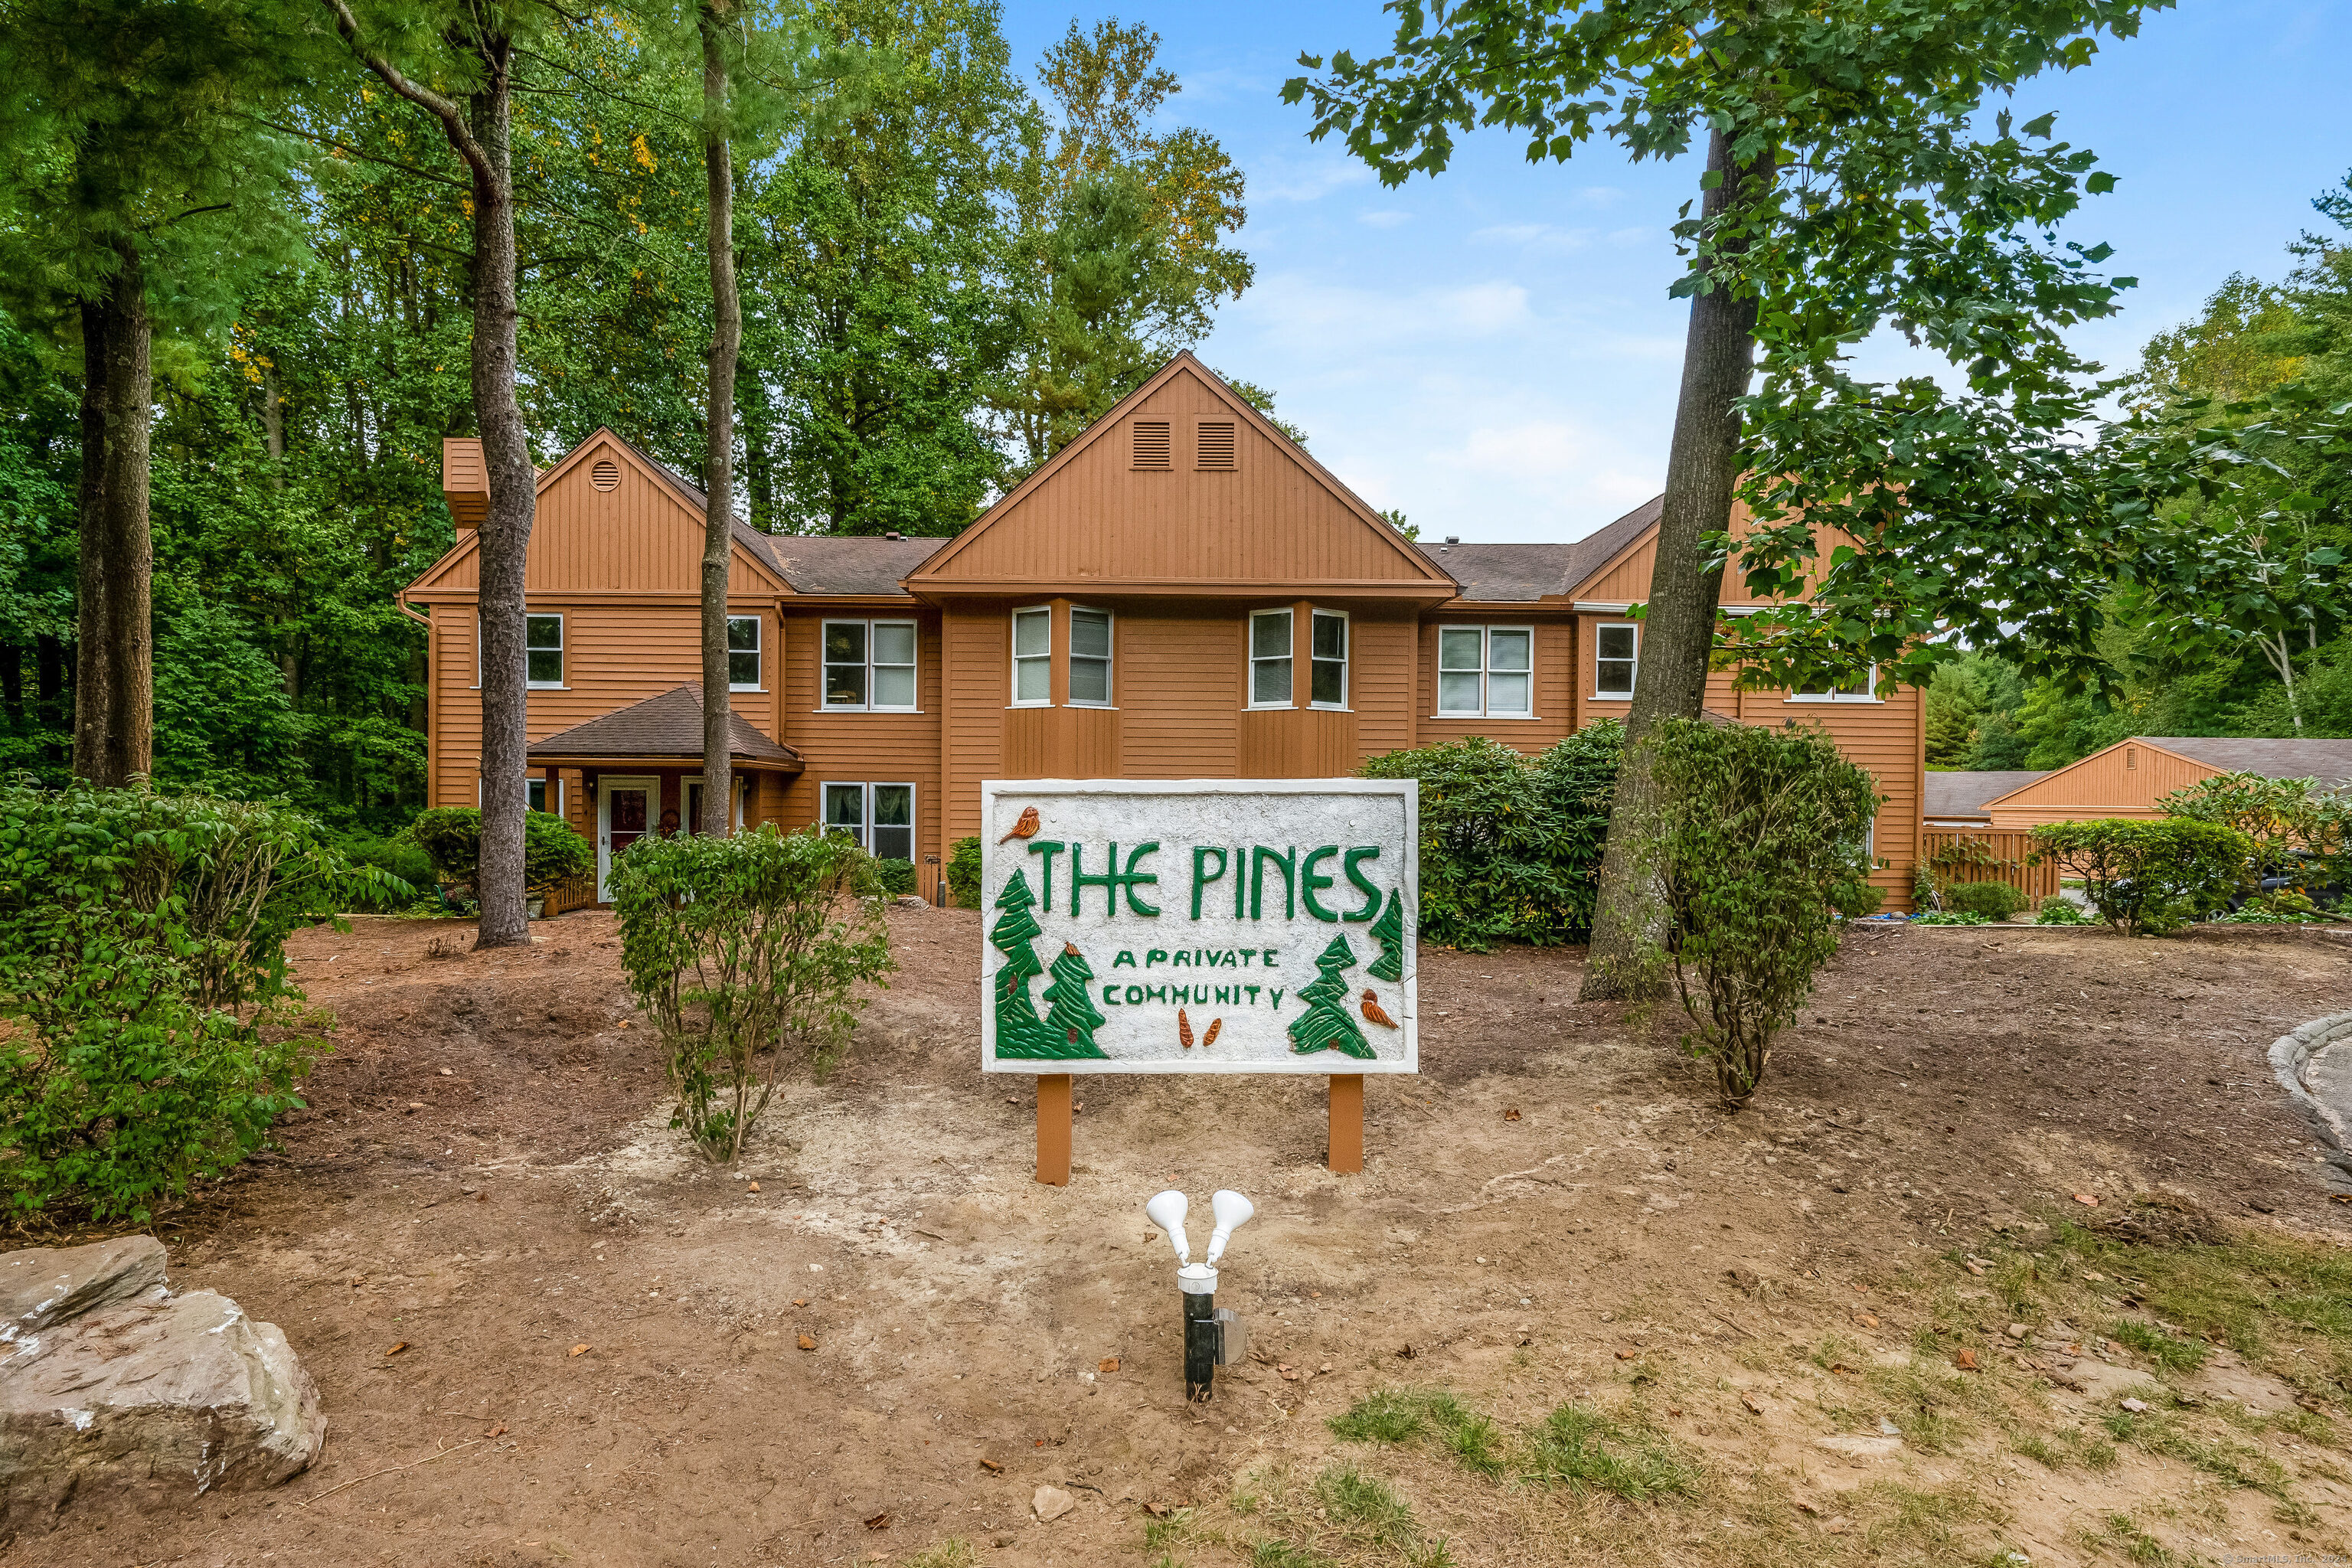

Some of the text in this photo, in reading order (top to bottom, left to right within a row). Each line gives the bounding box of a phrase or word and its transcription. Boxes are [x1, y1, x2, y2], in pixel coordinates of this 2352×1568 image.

[1027, 840, 1383, 923] THE PINES
[1112, 948, 1279, 969] A PRIVATE
[1102, 984, 1285, 1011] COMMUNITY
